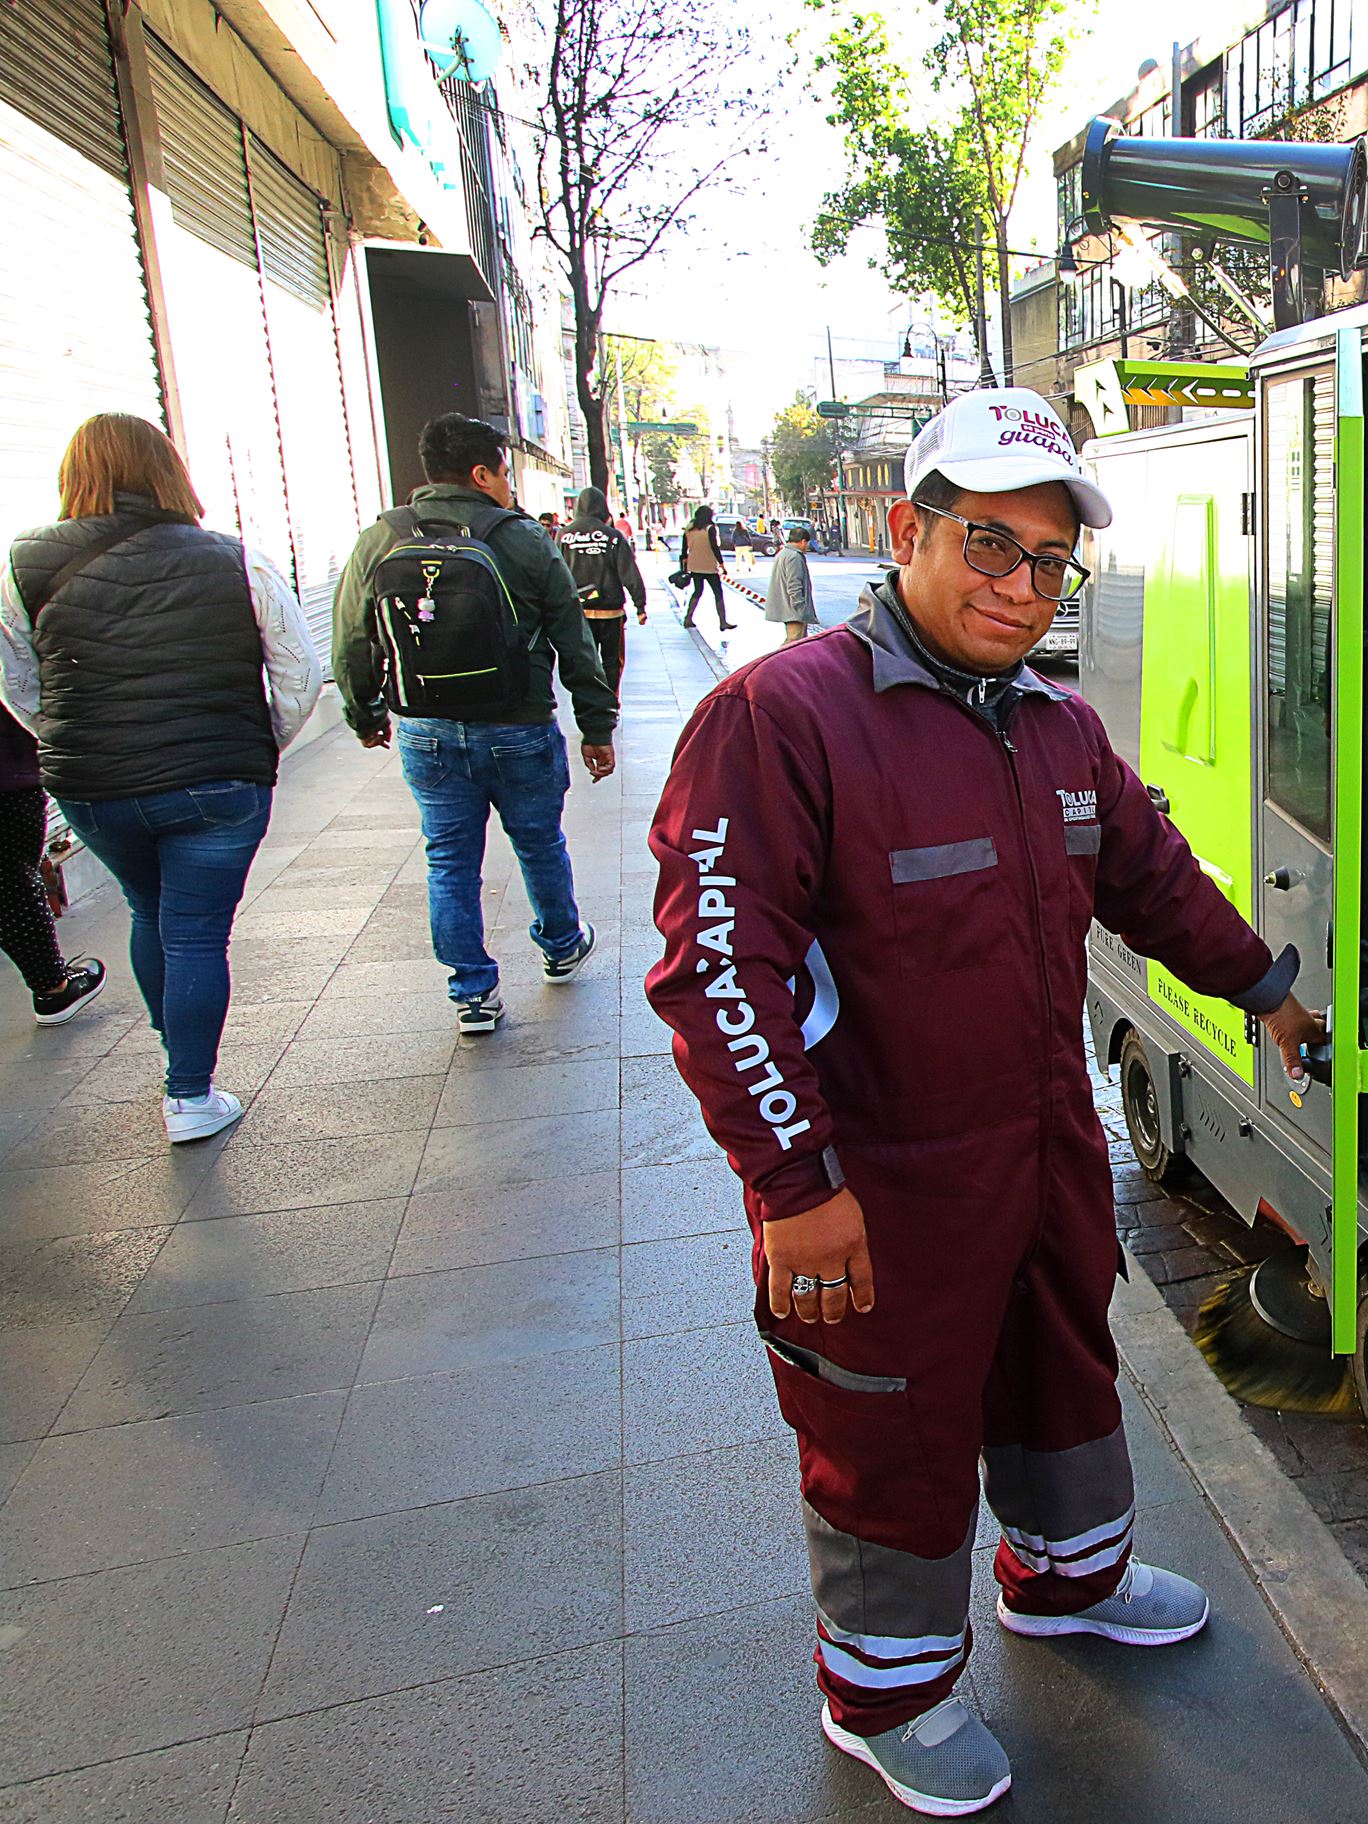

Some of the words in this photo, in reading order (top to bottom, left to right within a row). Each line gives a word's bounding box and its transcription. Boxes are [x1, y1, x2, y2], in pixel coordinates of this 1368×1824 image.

[997, 429, 1074, 466] guapa
[687, 817, 737, 973] APIAL
[1096, 925, 1114, 951] PURE
[1117, 943, 1142, 975] GREEN
[1157, 978, 1190, 1018] PLEASE
[1193, 1007, 1237, 1057] RECYCLE
[704, 964, 811, 1151] TOLUCA
